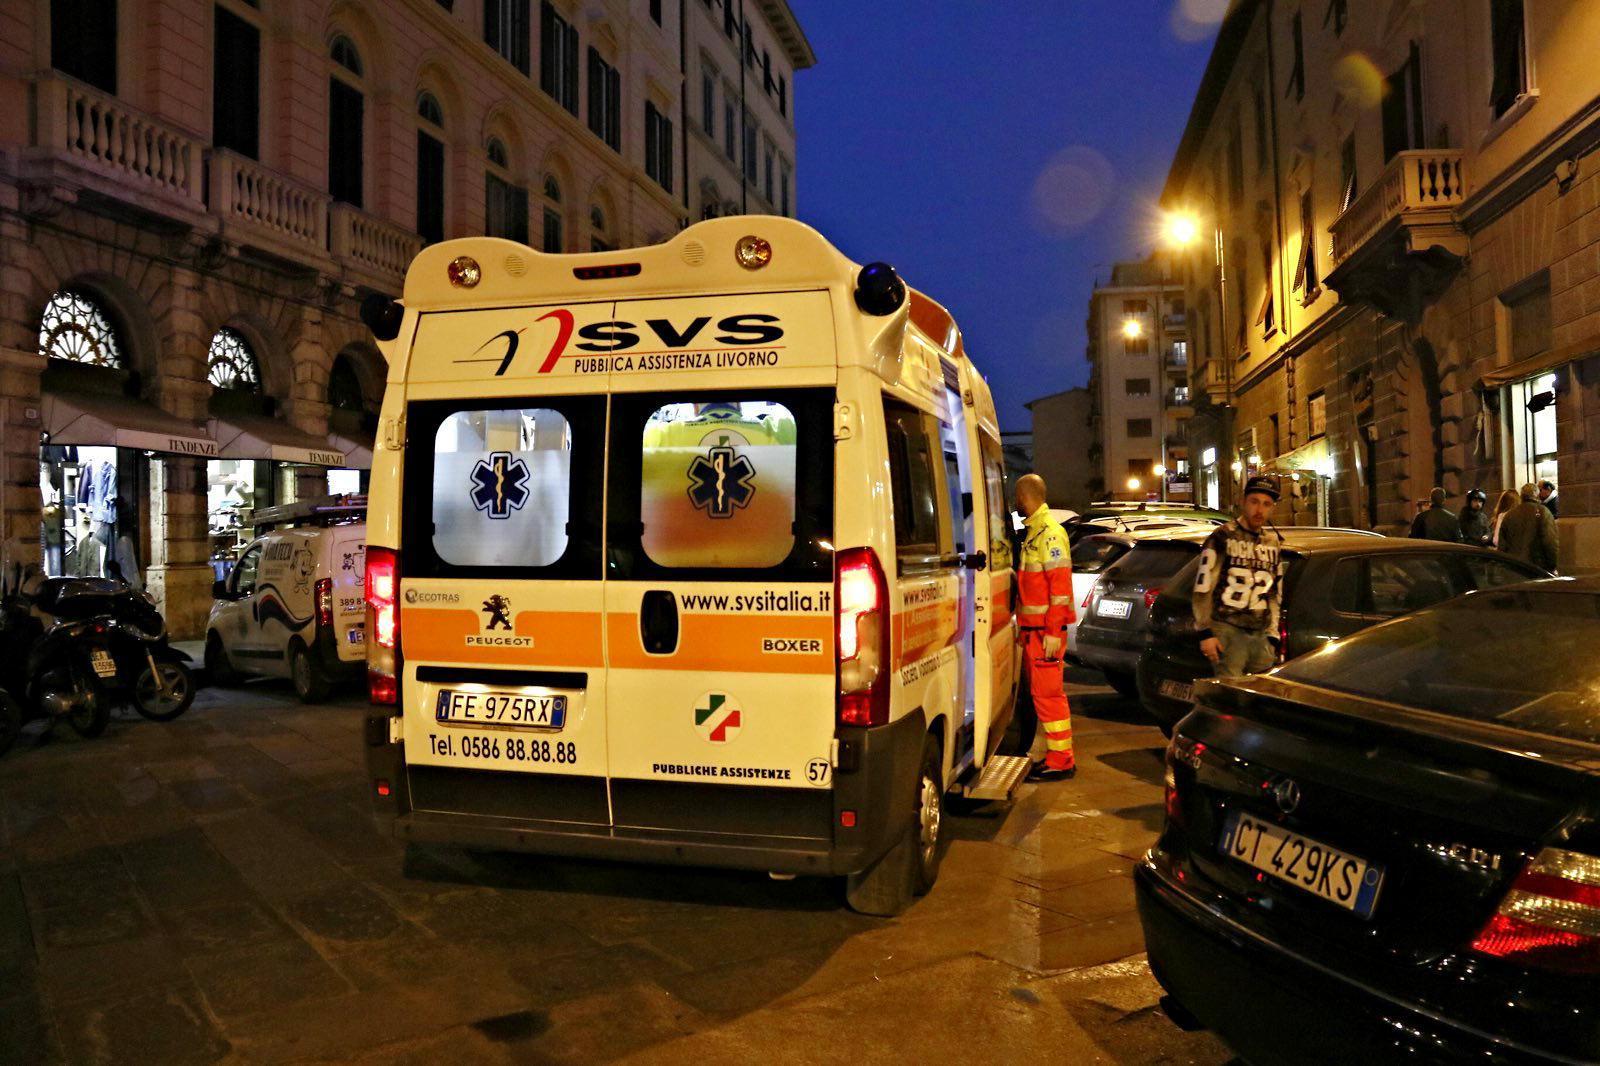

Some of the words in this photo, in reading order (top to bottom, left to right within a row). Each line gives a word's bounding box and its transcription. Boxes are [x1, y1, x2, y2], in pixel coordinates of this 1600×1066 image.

[575, 313, 784, 352] SVS
[575, 357, 634, 374] PUBBLICA
[638, 353, 712, 370] ASSISTENZA
[717, 351, 778, 367] LIVORNO
[168, 439, 217, 456] TENDENZE
[309, 452, 344, 466] TENDENZE
[418, 593, 460, 603] ECOTRAS
[1221, 567, 1274, 610] 82
[681, 590, 831, 612] www.svsitalia.it
[466, 636, 533, 646] PEUGEOT
[763, 639, 820, 652] BOXER
[451, 694, 478, 718] FE
[485, 696, 550, 723] 975RX
[429, 734, 457, 757] Tel.
[461, 735, 500, 759] 0586
[506, 738, 577, 764] 88.88.88
[652, 763, 718, 777] PUBBLICHE
[720, 766, 791, 780] ASSISTENZE
[808, 762, 829, 782] 57
[1235, 819, 1268, 862] CT
[1271, 834, 1359, 901] 429KS
